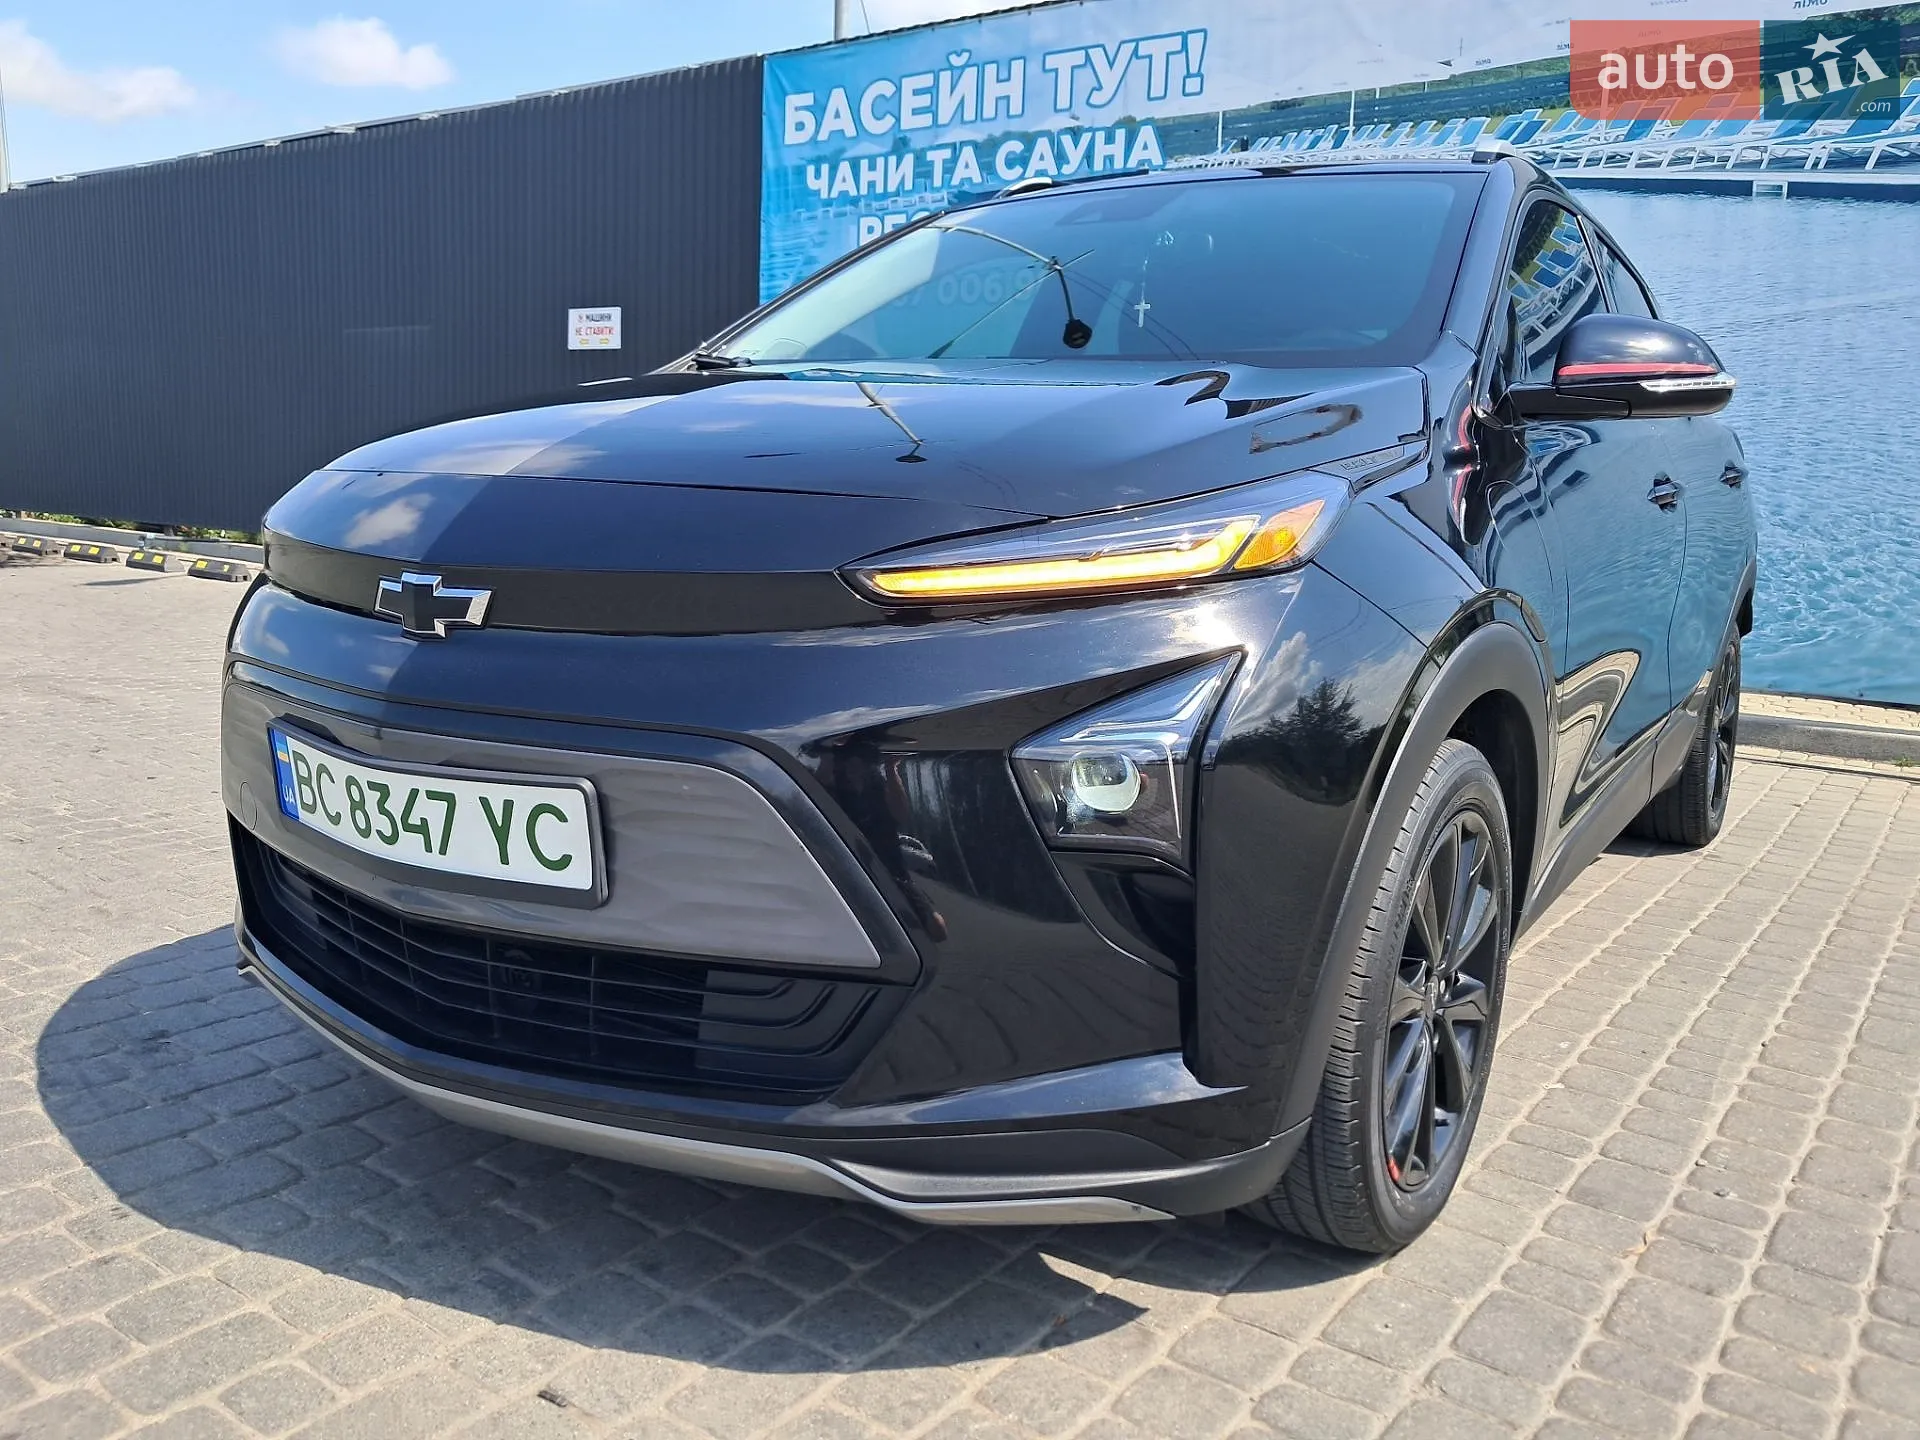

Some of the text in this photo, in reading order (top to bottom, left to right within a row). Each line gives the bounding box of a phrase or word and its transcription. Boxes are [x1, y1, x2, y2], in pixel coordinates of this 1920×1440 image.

[784, 29, 1207, 145] БАСЕЙН ТУТ!
[806, 124, 1164, 199] ЧАНИ ТА САУНА
[859, 210, 931, 246] РЕ
[292, 750, 573, 872] BC 8347 YC
